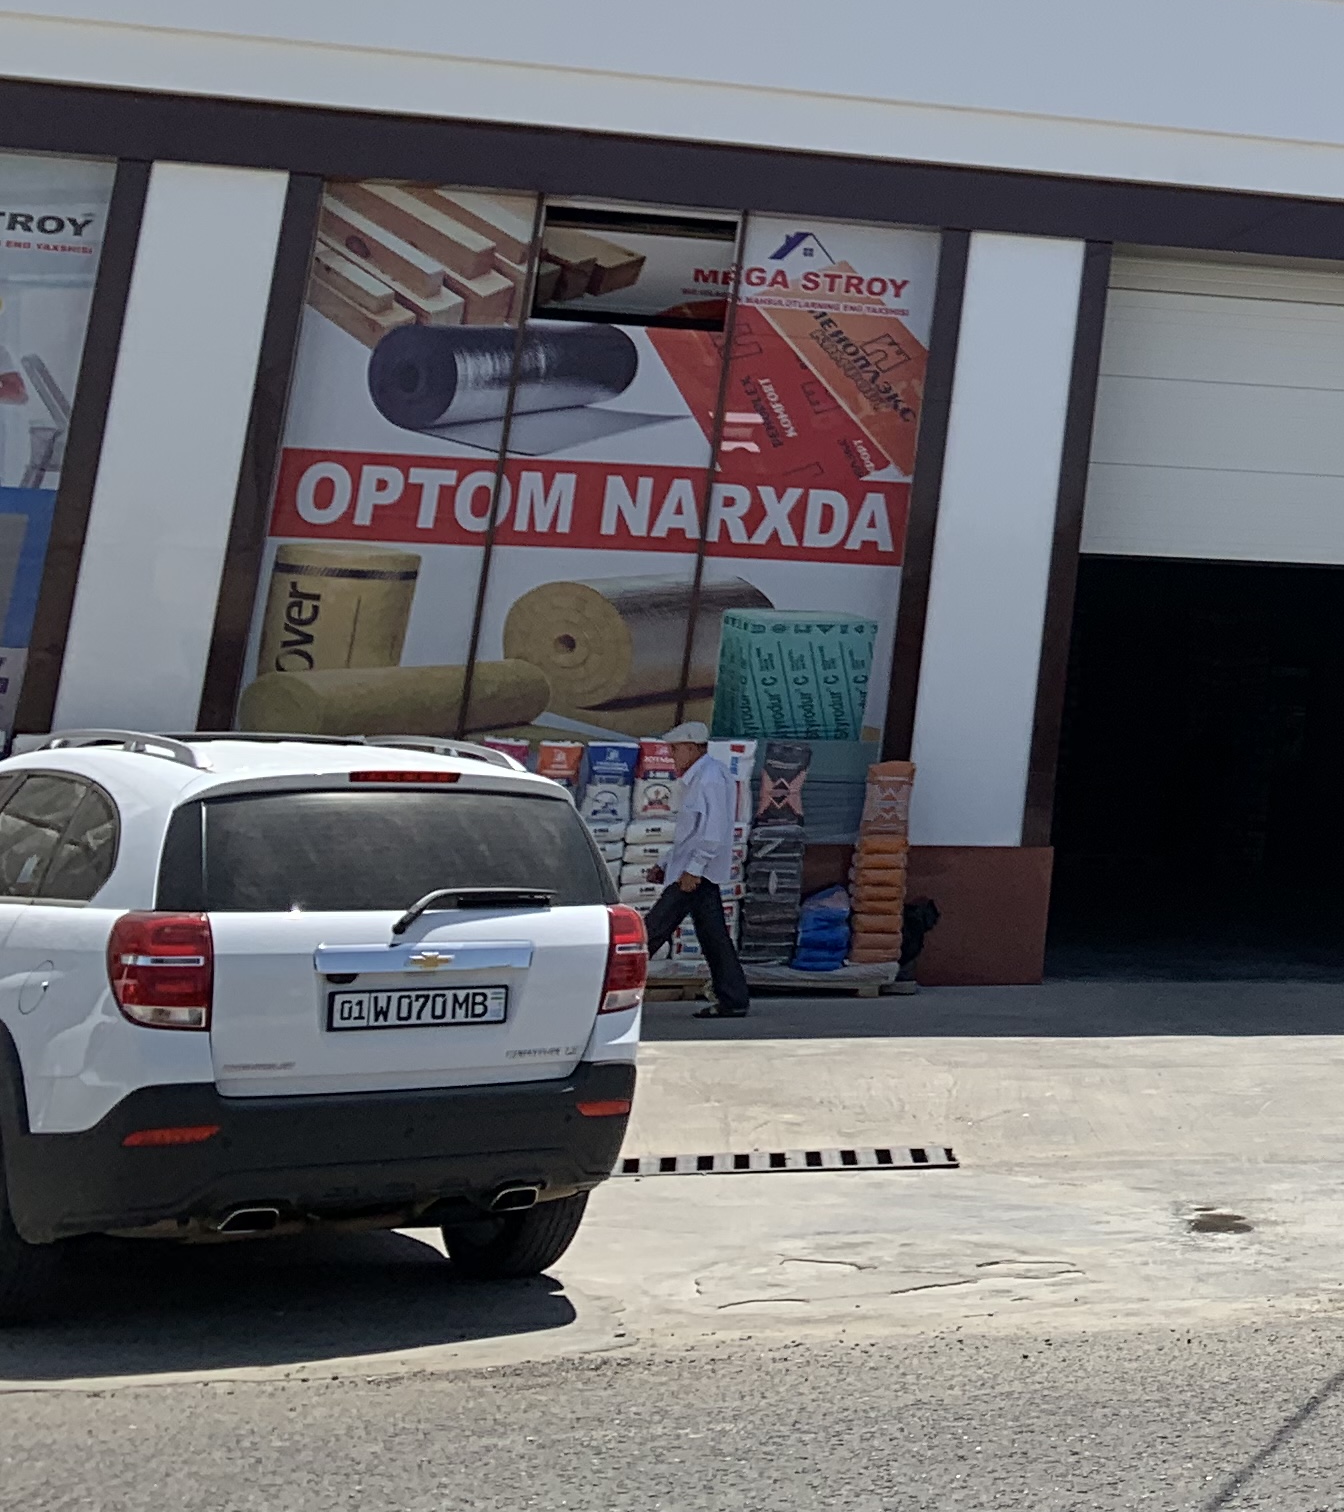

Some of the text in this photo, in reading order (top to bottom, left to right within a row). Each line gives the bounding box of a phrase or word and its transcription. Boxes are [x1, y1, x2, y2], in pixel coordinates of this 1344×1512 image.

[0, 210, 95, 237] ROY
[693, 266, 911, 298] MEGA STROY
[295, 460, 895, 553] OPTOM NARXDA
[340, 999, 366, 1021] 01
